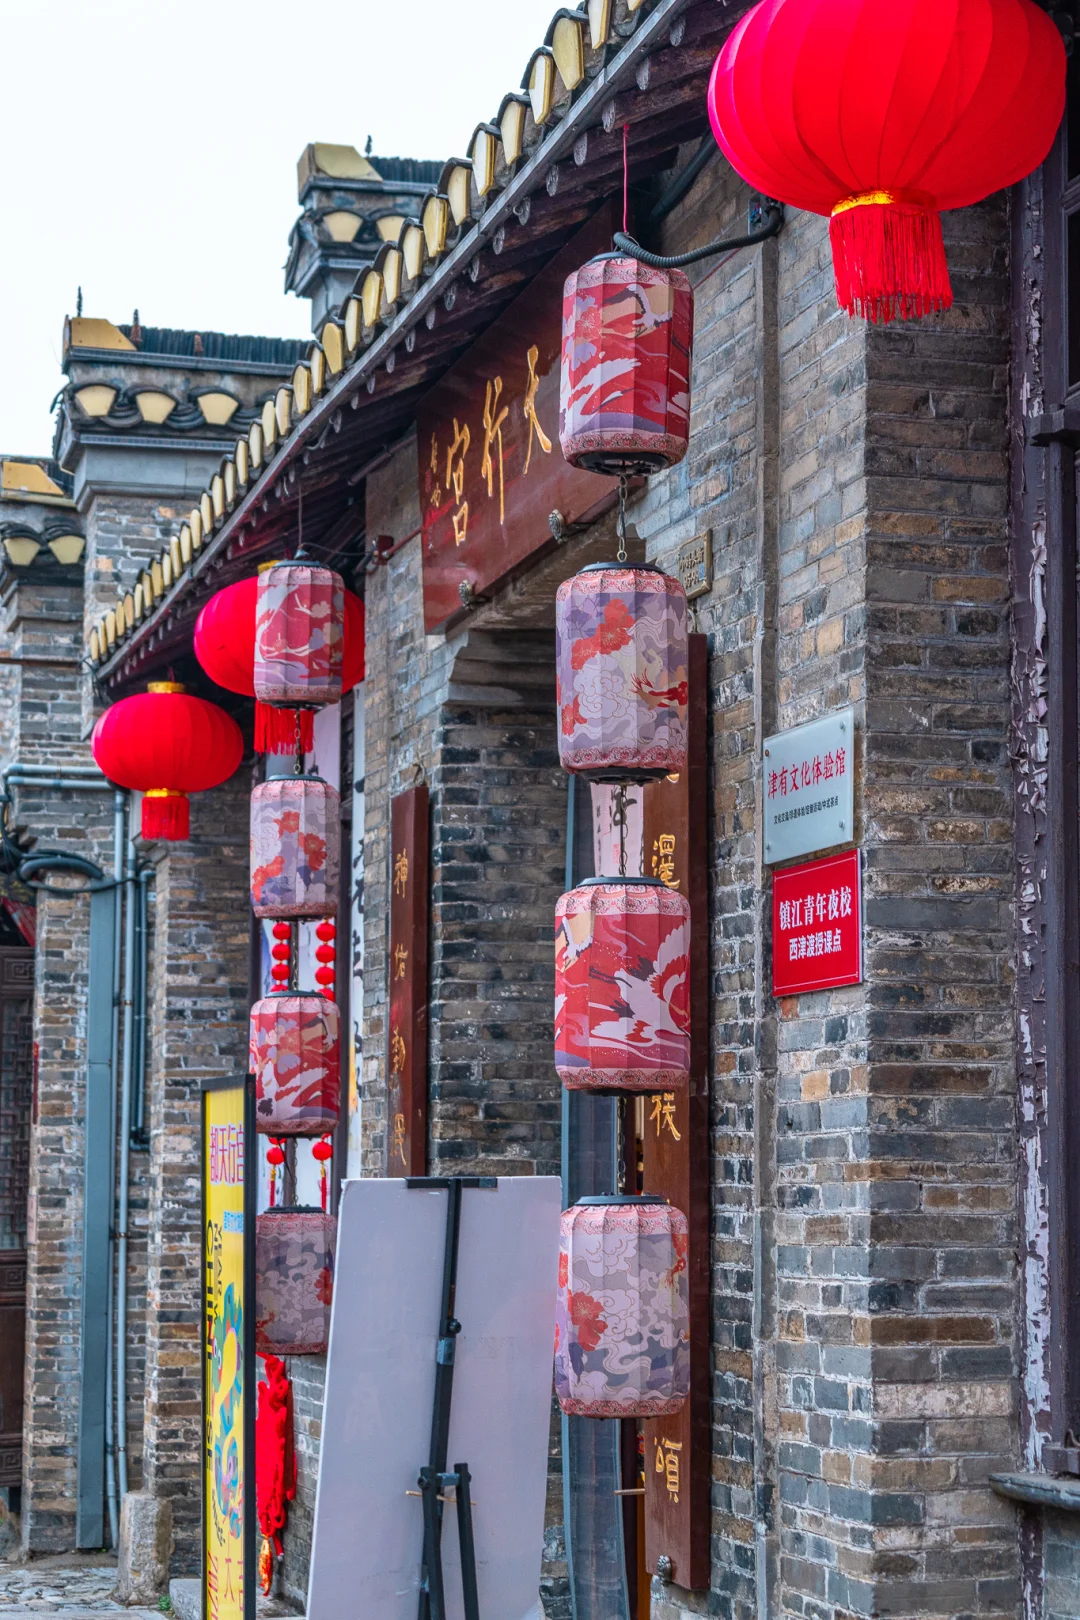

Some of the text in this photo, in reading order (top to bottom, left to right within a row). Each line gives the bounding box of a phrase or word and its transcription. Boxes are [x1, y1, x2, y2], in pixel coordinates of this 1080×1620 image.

[767, 747, 846, 800] 津有文化体验馆
[779, 886, 852, 931] 镇江青年夜校
[788, 927, 842, 962] 西津渡授课点
